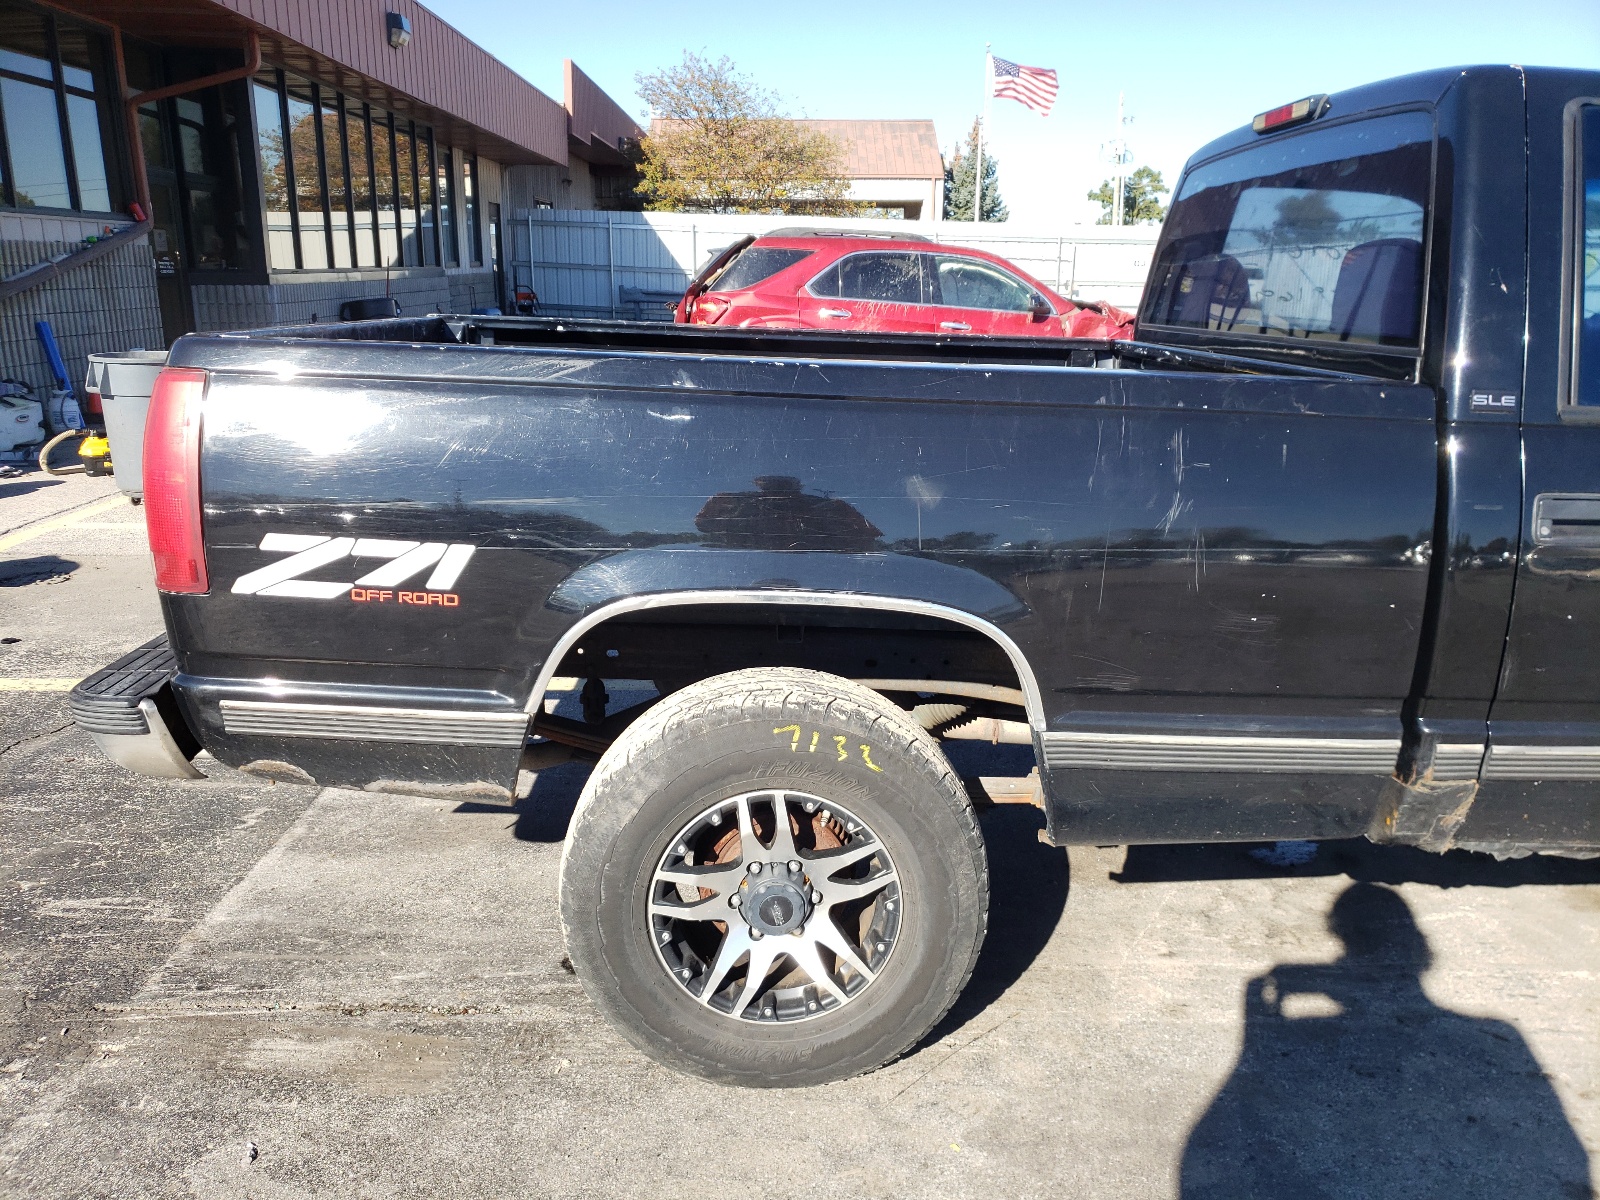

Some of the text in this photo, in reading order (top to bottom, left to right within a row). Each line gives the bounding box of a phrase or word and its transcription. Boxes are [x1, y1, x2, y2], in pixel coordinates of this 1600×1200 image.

[1472, 394, 1516, 407] SLE
[231, 532, 477, 599] Z71
[351, 588, 459, 606] OFF ROAD
[772, 724, 884, 773] 7132
